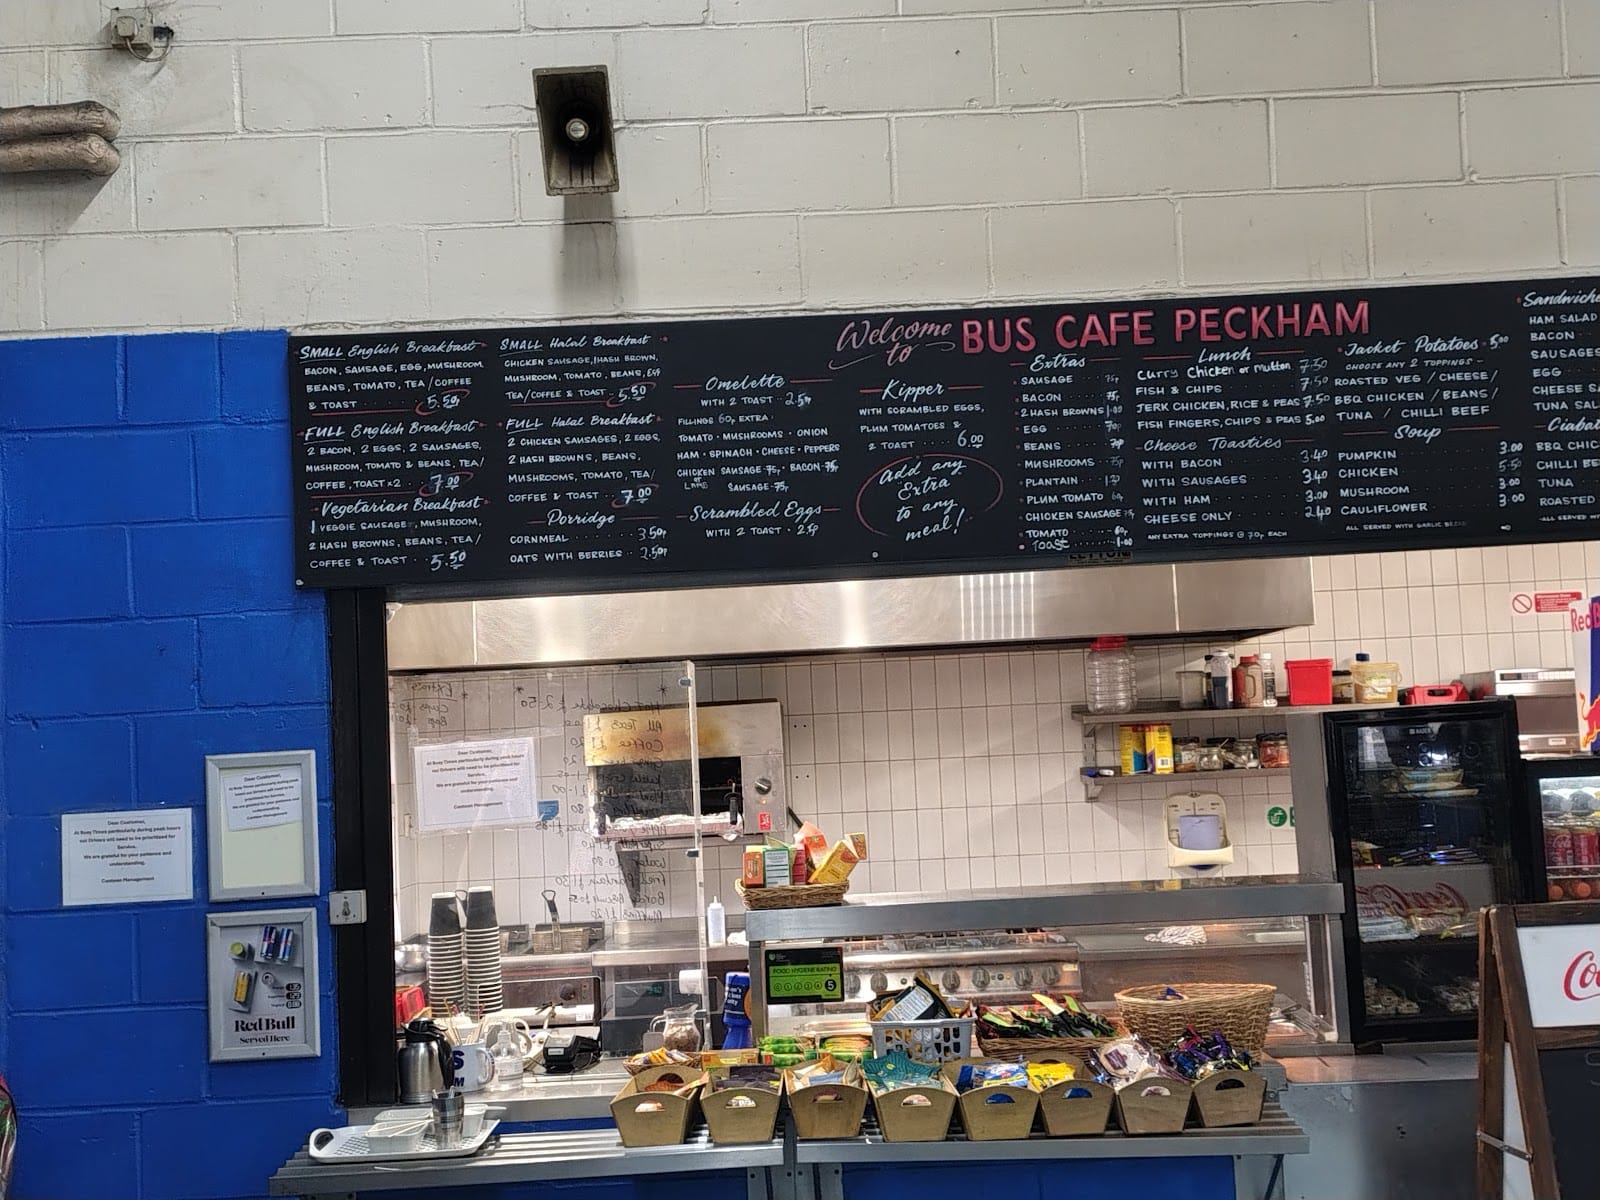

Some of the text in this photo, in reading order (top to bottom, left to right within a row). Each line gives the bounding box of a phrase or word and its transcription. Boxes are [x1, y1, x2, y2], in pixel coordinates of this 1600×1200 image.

[1530, 313, 1597, 324] HAM SALAD
[963, 301, 1370, 354] BUS CAFE PECKHAM
[837, 318, 953, 353] Welcome
[500, 335, 651, 350] SMALL Halal Breakfast
[1345, 336, 1478, 356] Jacket Potatoes
[300, 341, 478, 359] SMALL English Breakfast
[887, 343, 913, 366] to
[1198, 347, 1251, 363] Lunch
[505, 359, 544, 367] CHICKEN
[1030, 353, 1085, 371] Extras
[1424, 358, 1472, 366] TOPPINGS
[1187, 366, 1233, 378] Chicken
[1533, 368, 1561, 377] EGG
[706, 374, 784, 390] Omelette
[1021, 375, 1072, 385] SAUSAGE
[1335, 375, 1421, 386] ROASTED VEG
[882, 379, 944, 402] Kipper
[1136, 385, 1221, 395] FISH CHIPS
[1533, 385, 1582, 395] CHEESE
[741, 396, 773, 404] TOAST
[1023, 394, 1061, 402] BACON
[1335, 392, 1424, 405] BBQ CHICKEN
[322, 401, 357, 409] TOAST
[888, 405, 949, 414] SCRAMBLED
[1137, 403, 1169, 413] JERK
[1274, 398, 1300, 407] PEAS
[1063, 407, 1104, 416] BROWNS
[1336, 406, 1489, 420] TUNA CHILLI BEEF
[506, 413, 655, 431] FULL Halal Breakfast
[678, 417, 713, 425] FILLINGS
[892, 422, 944, 431] TOMATOES
[1137, 421, 1163, 429] FISH
[305, 420, 478, 441] FULL English Breakfast
[1024, 425, 1047, 433] EGG
[1395, 425, 1441, 443] Soup
[679, 428, 828, 442] TOMATO MUSHROOMS ONION
[521, 438, 561, 446] CHICKEN
[881, 441, 914, 449] TOAST
[1024, 442, 1061, 450] BEANS
[1144, 436, 1281, 451] Cheese Toasties
[1536, 442, 1563, 451] BBQ
[677, 444, 840, 459] HAM SPINACH CHEESE PEPPERS
[1339, 450, 1396, 460] PUMPKIN
[520, 456, 544, 464] HASH
[1025, 458, 1095, 468] MUSHROOMS
[1181, 459, 1221, 468] BACON
[1537, 460, 1577, 470] CHILLI
[365, 462, 401, 470] TOMATO
[677, 468, 715, 478] CHICKEN
[878, 461, 966, 486] Add any
[1339, 467, 1398, 478] CHICKEN
[1026, 477, 1077, 487] PLANTAIN
[1181, 475, 1246, 486] SAUSAGES
[896, 476, 952, 502] Extra
[1340, 486, 1409, 497] MUSHROOM
[509, 493, 547, 502] COFFEE
[1027, 493, 1103, 504] PLUM TOMATO
[1184, 495, 1210, 504] HAM
[1540, 496, 1595, 506] ROASTED
[322, 497, 482, 519] Vegetarian Breakfast
[690, 501, 821, 523] Scrambled Eggs
[897, 499, 958, 522] to any
[1341, 503, 1427, 515] CAULIFLOWER
[547, 509, 615, 528] Porridge
[1026, 509, 1121, 521] CHICKEN SAUSAGE
[1144, 512, 1232, 524] CHEESE ONLY
[320, 523, 355, 531] VEGGIE
[1026, 529, 1068, 538] TOMATO
[510, 535, 568, 544] CORNMEAL
[510, 550, 622, 562] OATS WITH BERRIES
[310, 556, 407, 568] COFFEE TOAST
[1571, 606, 1592, 633] Red
[827, 980, 834, 990] 5
[234, 1016, 296, 1032] Red Bull
[239, 1036, 269, 1044] Served
